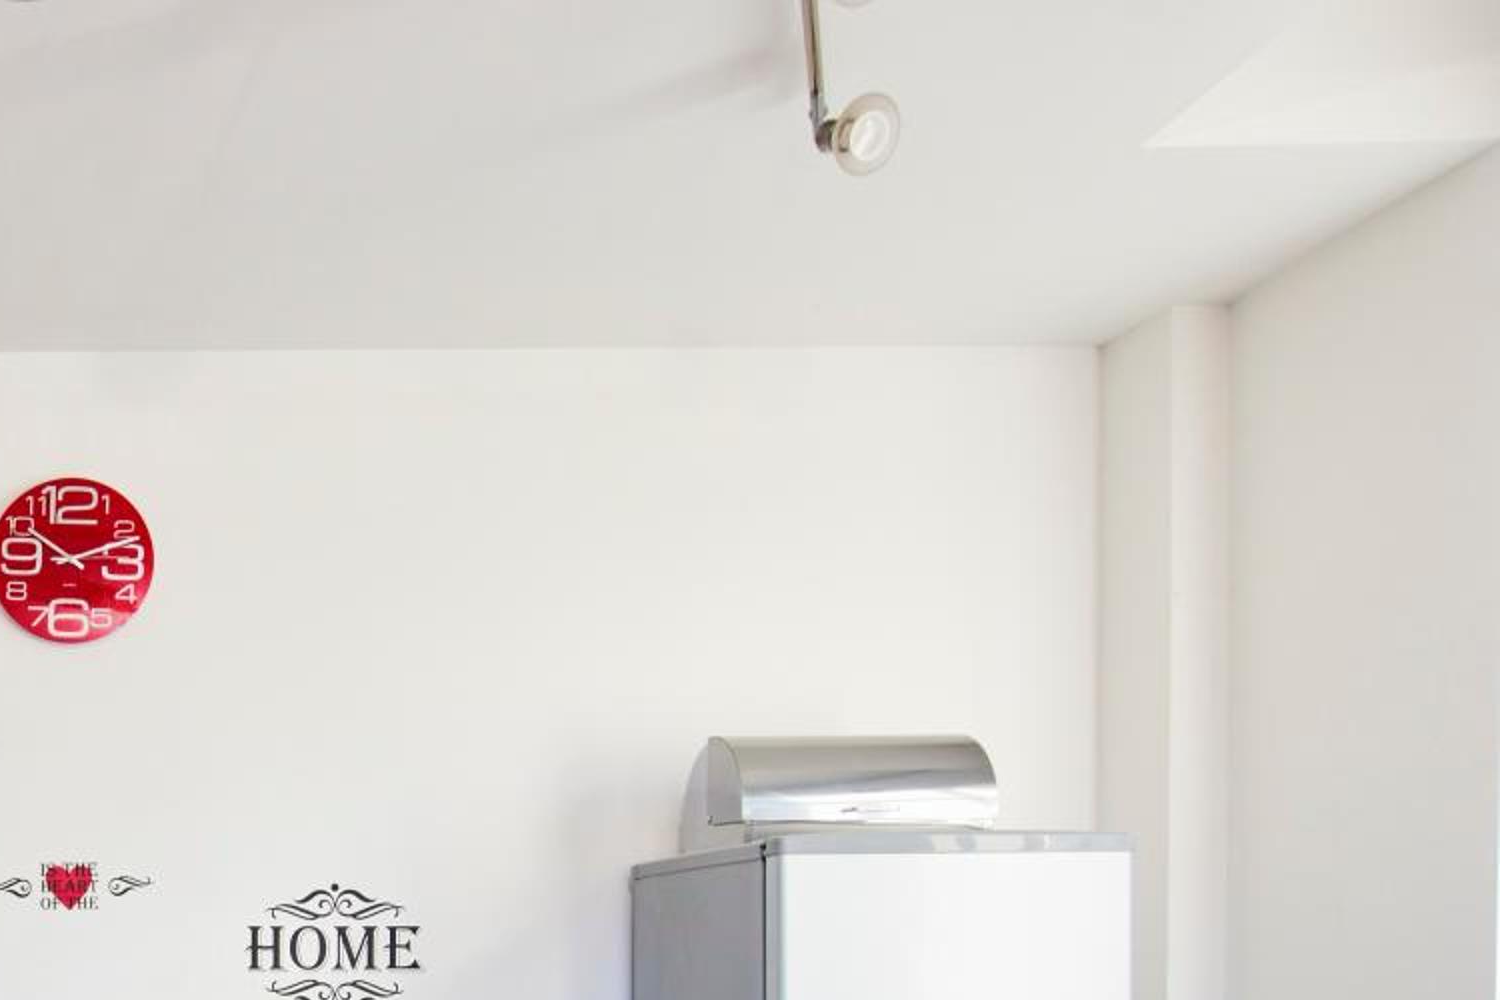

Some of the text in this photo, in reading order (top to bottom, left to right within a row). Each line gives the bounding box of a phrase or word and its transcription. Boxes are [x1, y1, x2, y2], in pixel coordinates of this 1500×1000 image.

[26, 495, 47, 517] 11
[41, 485, 99, 525] 12
[101, 495, 111, 515] 1
[6, 515, 35, 537] 10
[113, 519, 136, 540] 2
[0, 537, 43, 576] 9
[101, 543, 145, 581] 3
[5, 581, 28, 601] 8
[114, 583, 138, 605] 4
[27, 605, 49, 627] 7
[47, 598, 90, 638] 6
[90, 607, 113, 629] 5
[246, 925, 421, 970] HOME
